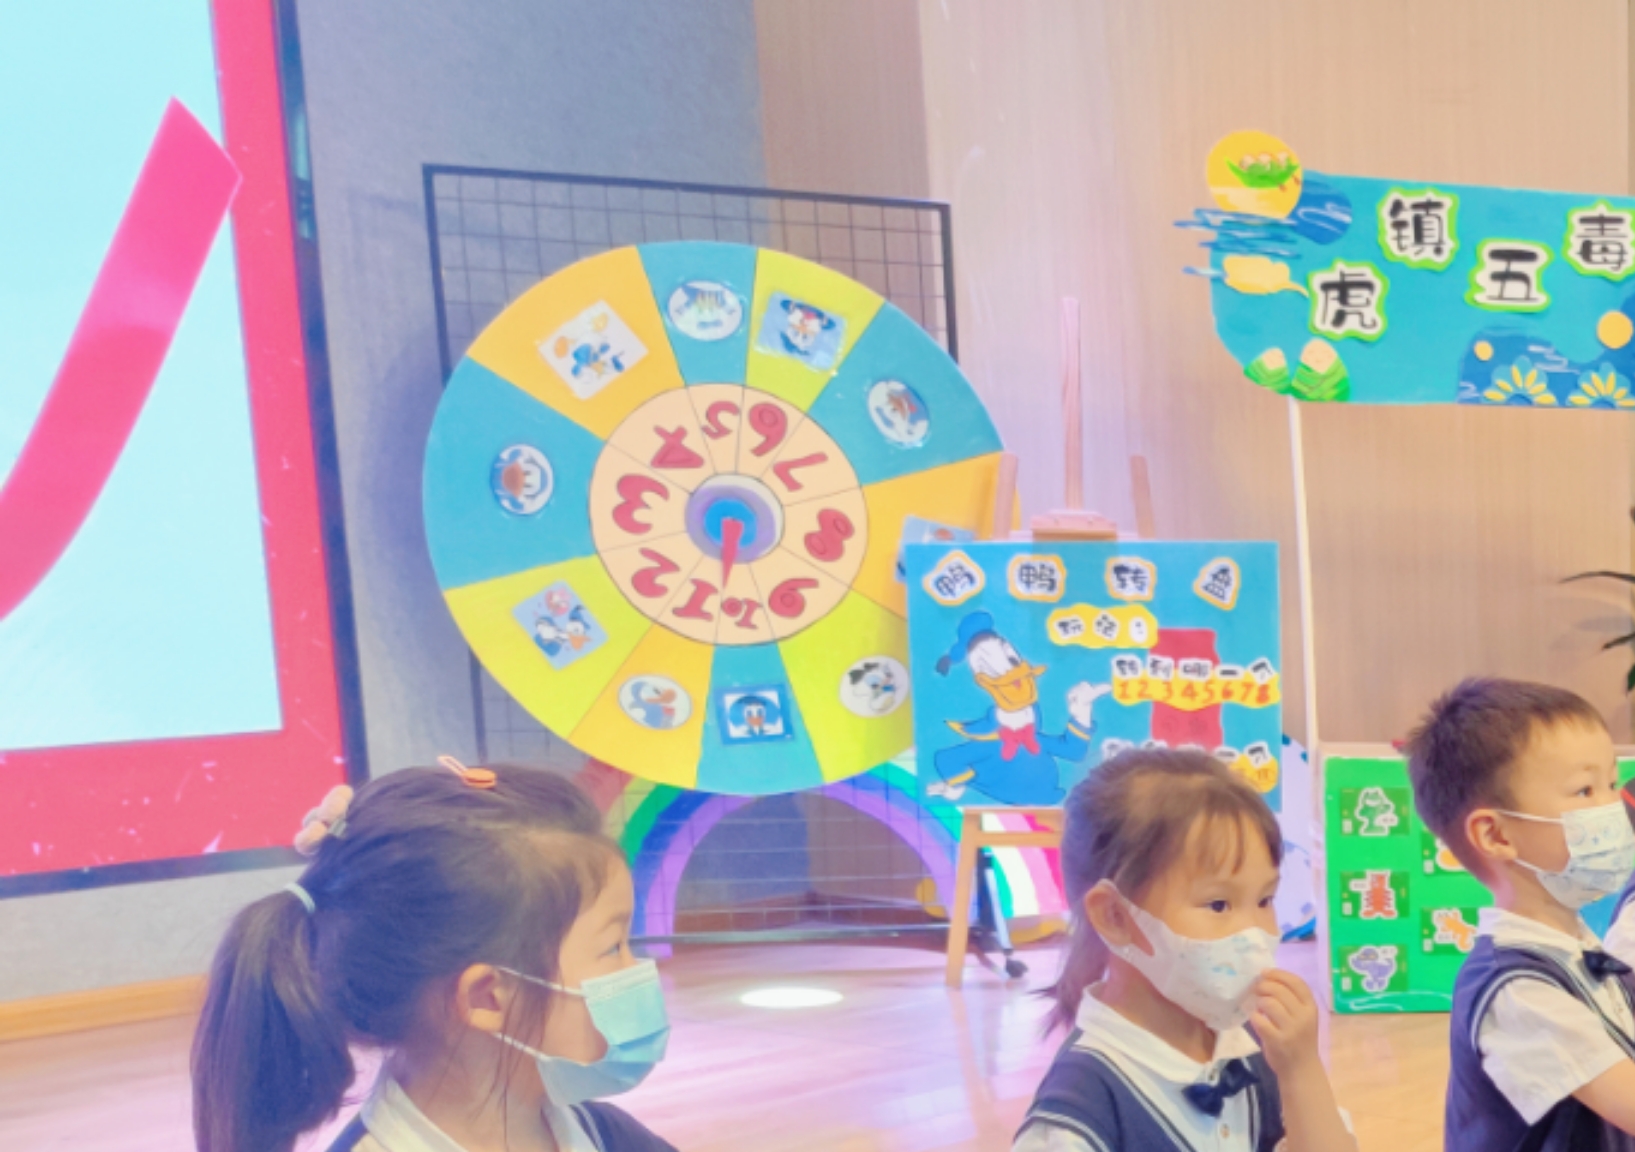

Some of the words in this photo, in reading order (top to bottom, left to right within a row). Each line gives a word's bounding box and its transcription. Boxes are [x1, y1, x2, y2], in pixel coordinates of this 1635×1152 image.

[702, 400, 742, 440] 5
[748, 402, 789, 457] 6
[649, 425, 705, 469] 4
[772, 452, 829, 492] 7
[611, 473, 670, 535] 3
[803, 508, 855, 562] 8
[631, 547, 681, 598] 2
[672, 577, 719, 622] 1
[768, 577, 820, 619] 9
